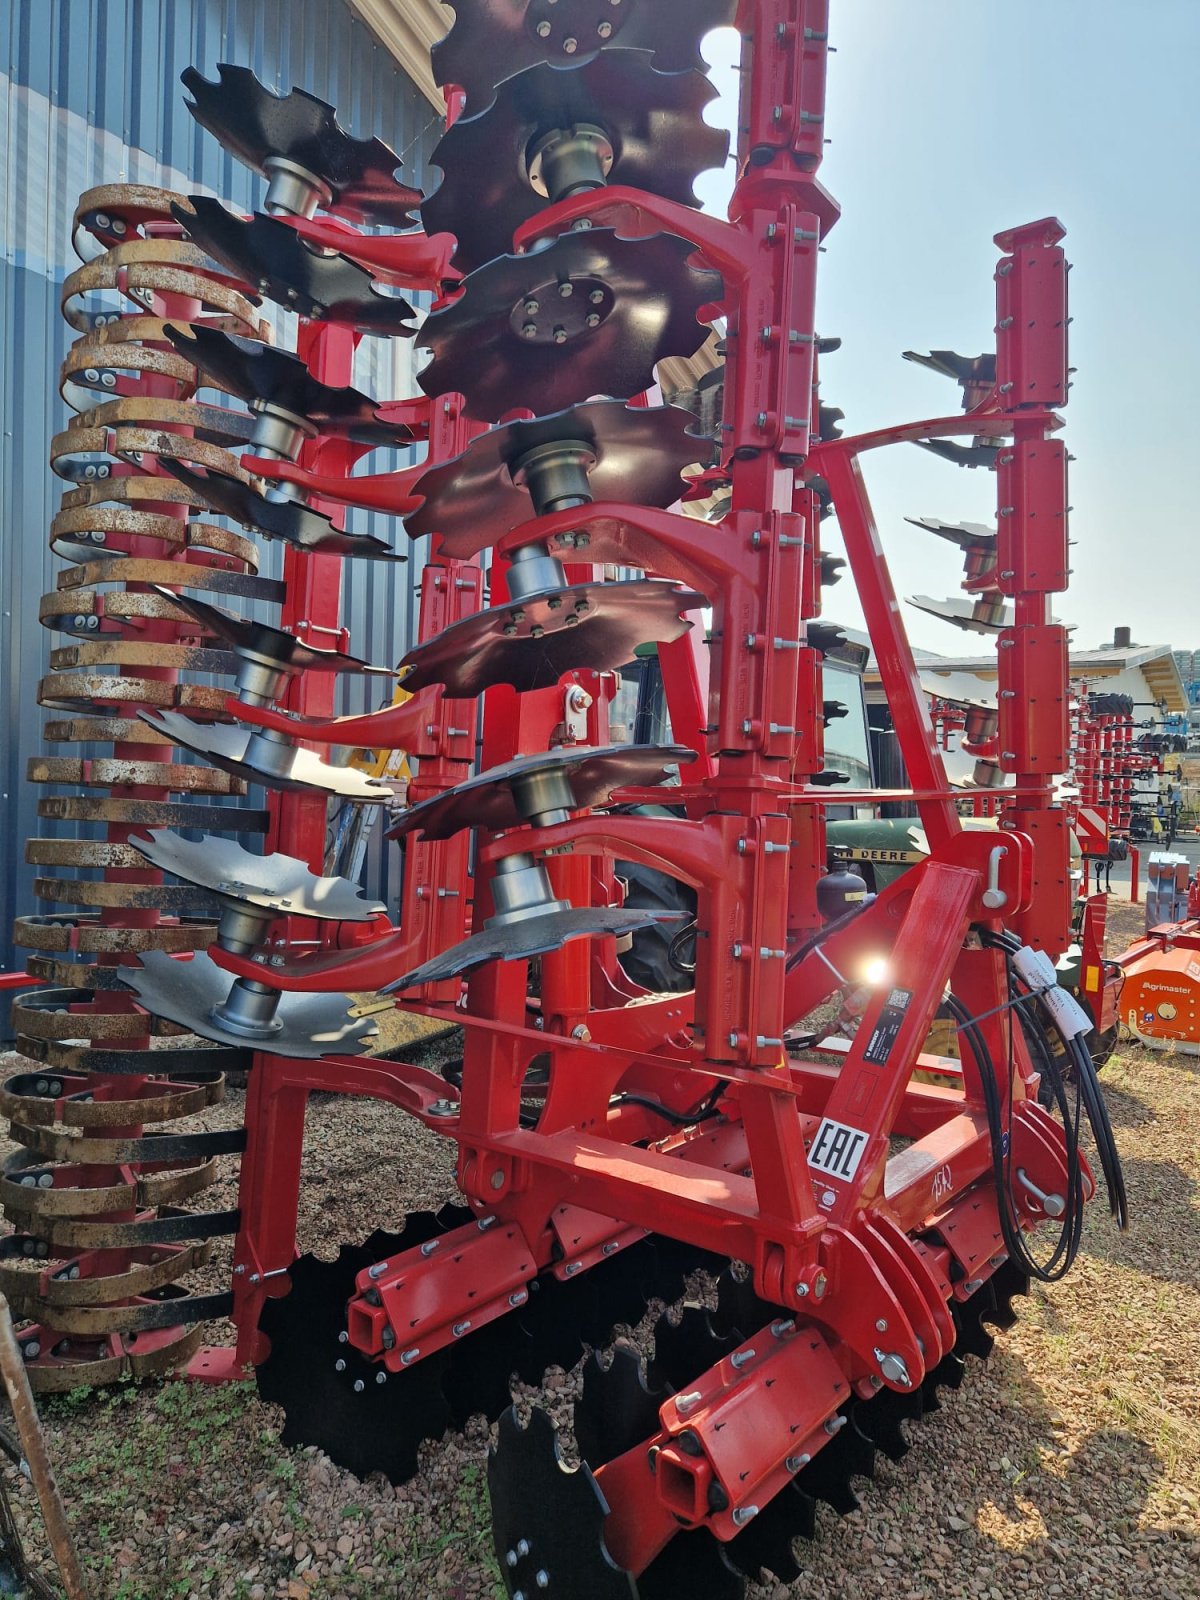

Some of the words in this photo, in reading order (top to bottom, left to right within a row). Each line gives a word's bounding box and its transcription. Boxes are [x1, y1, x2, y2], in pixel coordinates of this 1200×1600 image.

[861, 850, 908, 861] DEERE
[1142, 982, 1191, 994] Agrimaster
[811, 1122, 864, 1177] EAC
